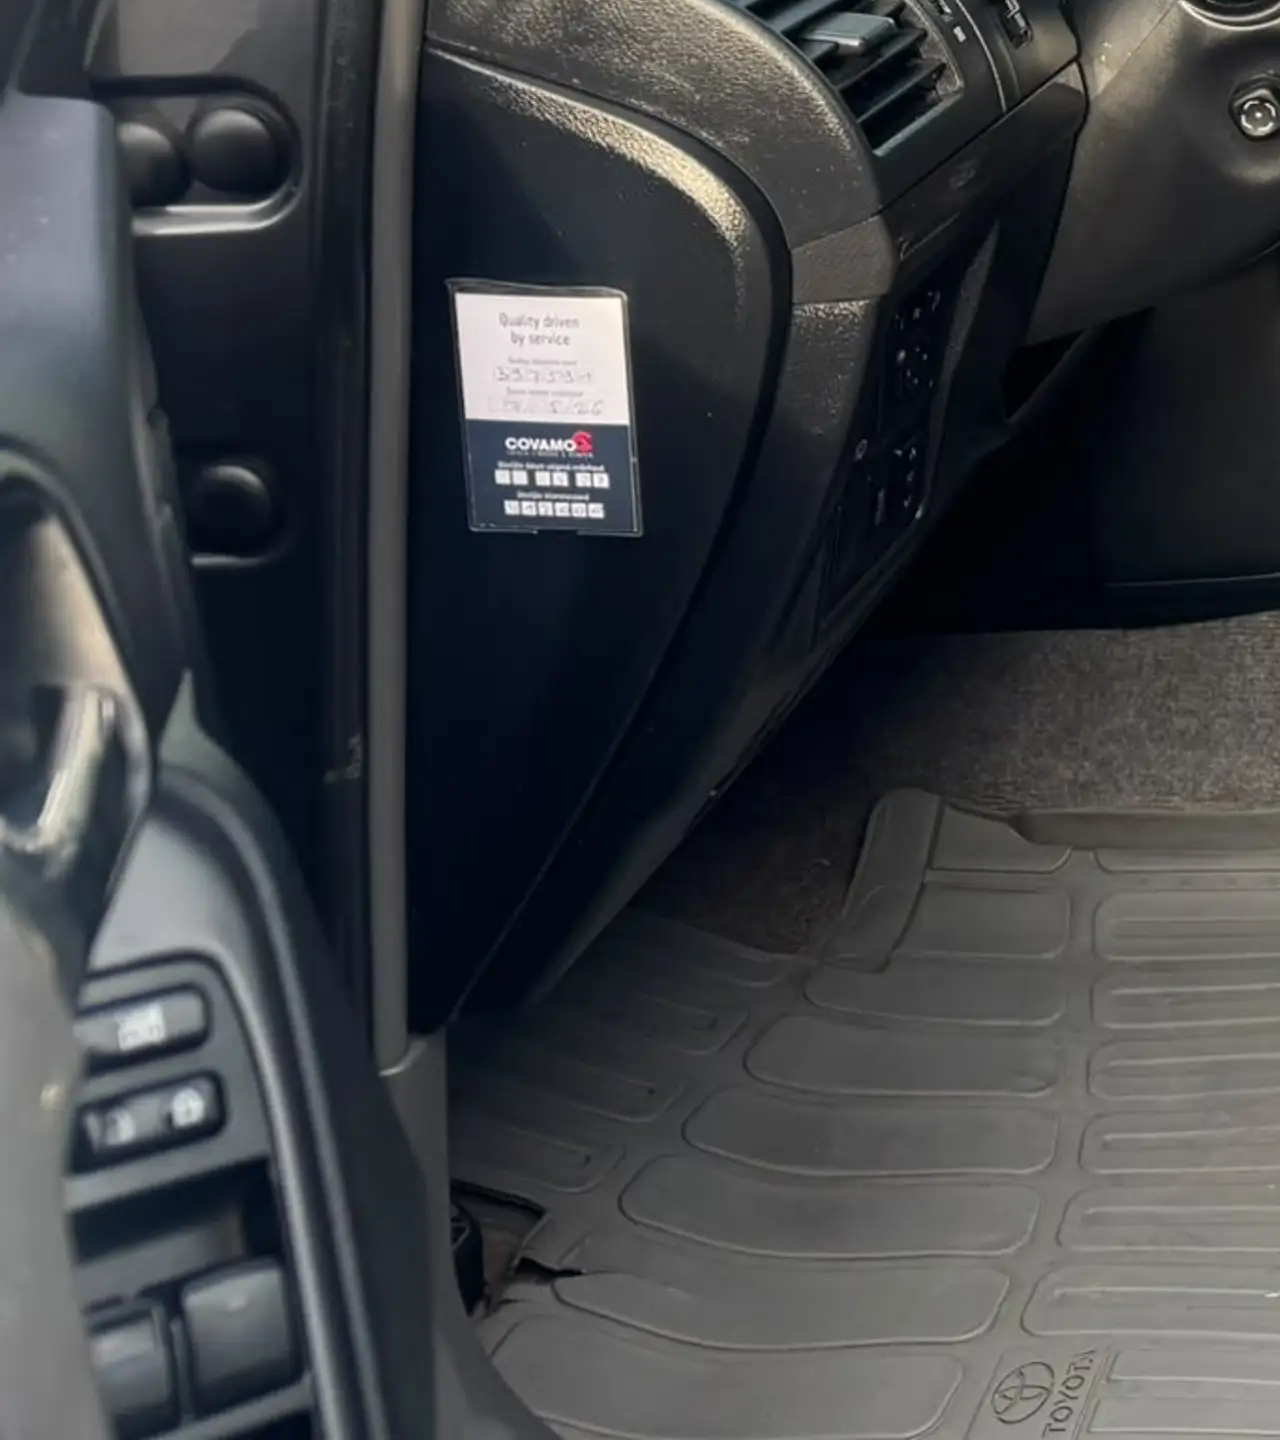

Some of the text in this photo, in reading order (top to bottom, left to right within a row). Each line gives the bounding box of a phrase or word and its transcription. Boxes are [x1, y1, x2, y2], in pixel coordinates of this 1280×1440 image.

[498, 312, 580, 330] Quality driven
[510, 329, 571, 347] by service
[1041, 1348, 1097, 1439] TOYOTA
